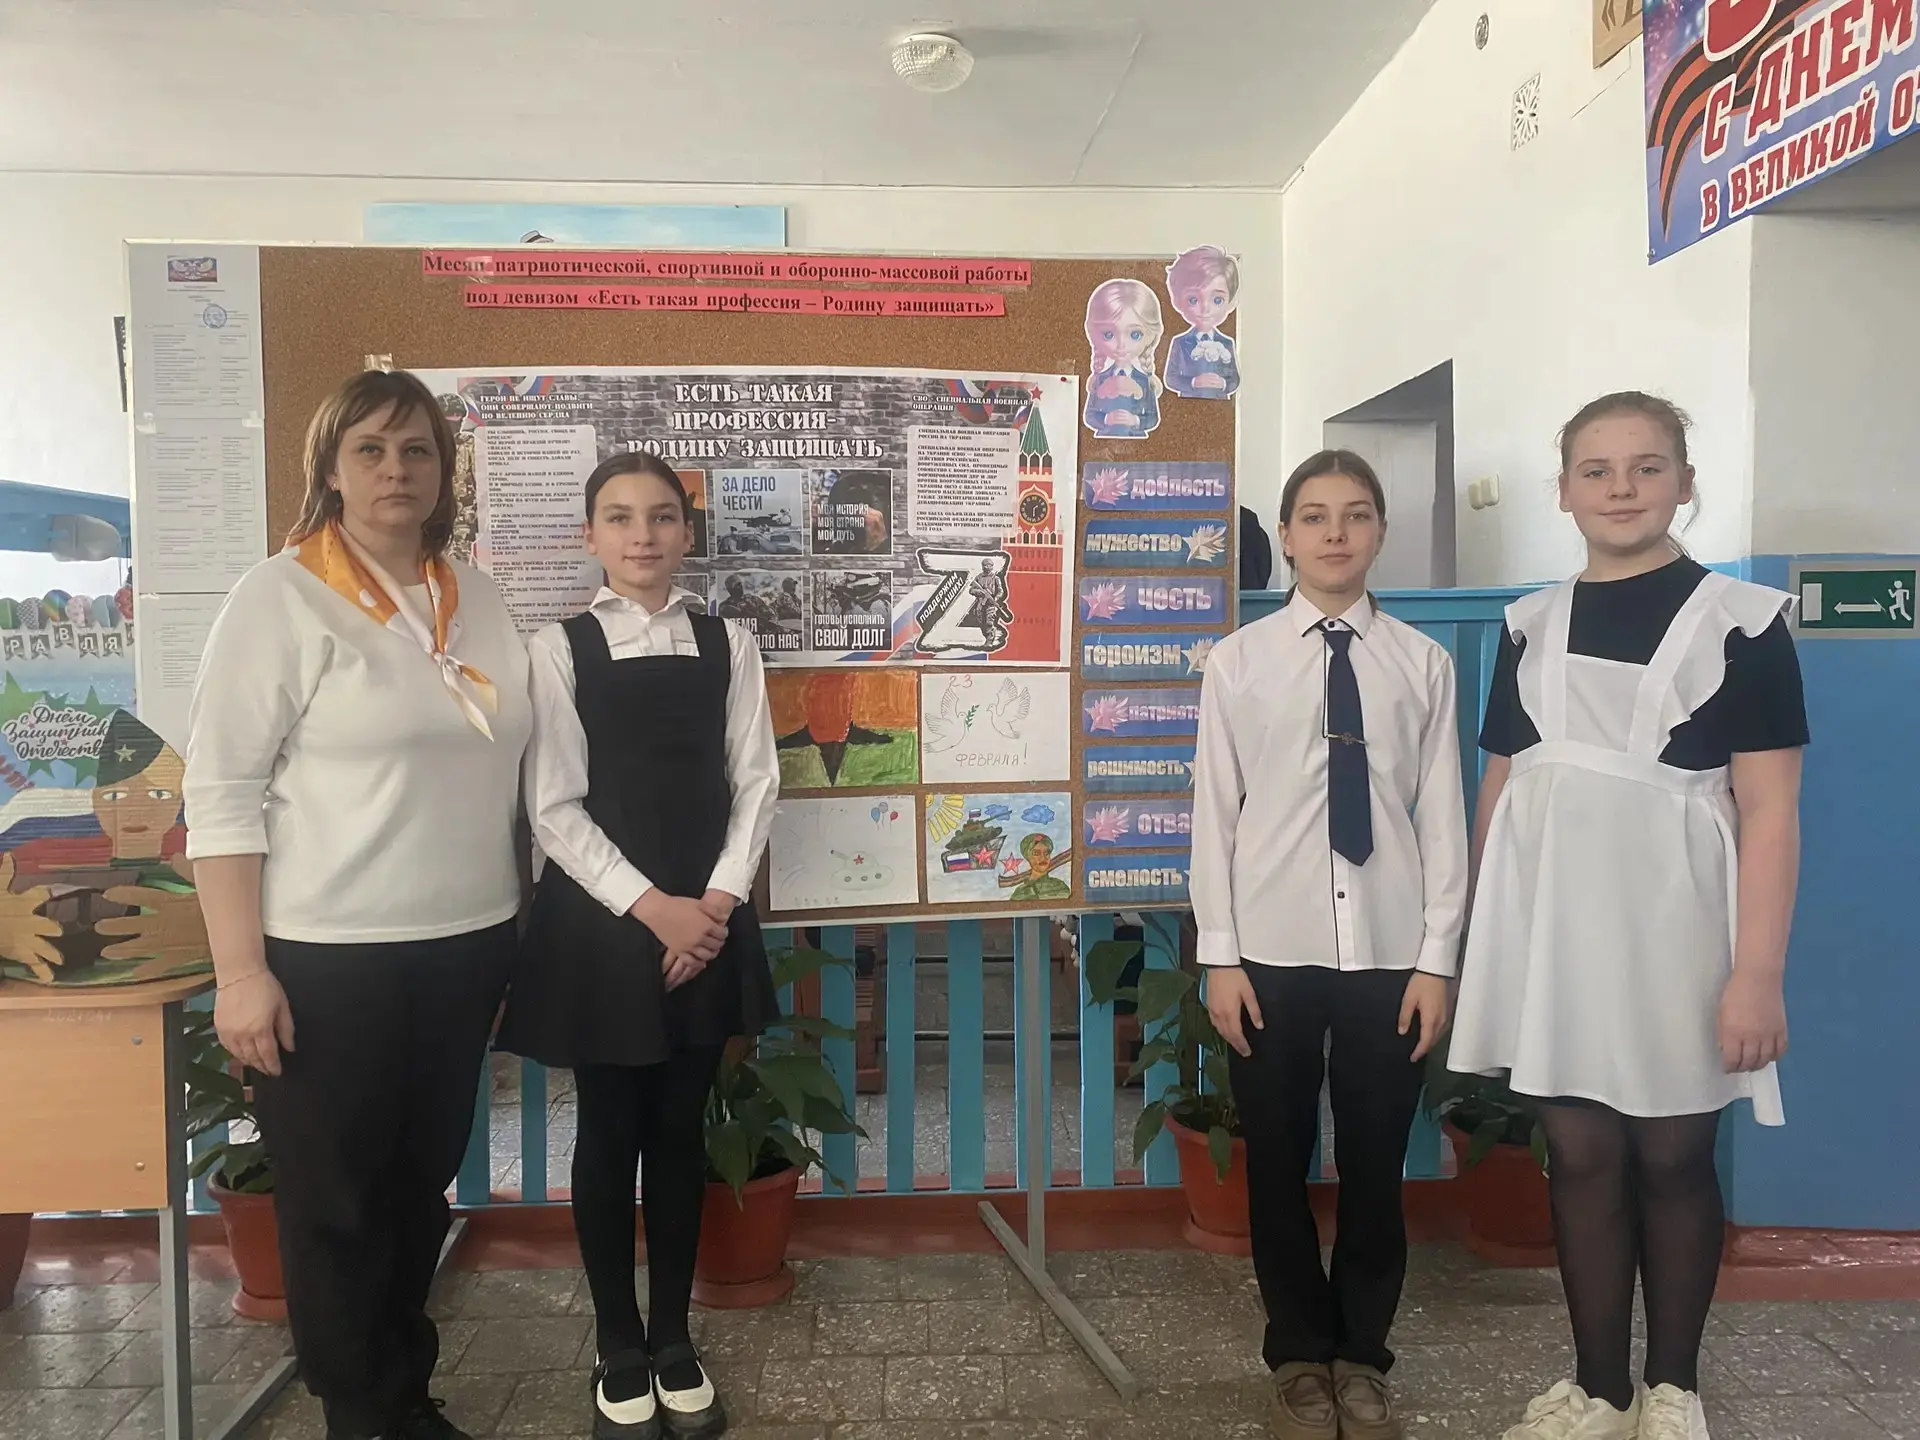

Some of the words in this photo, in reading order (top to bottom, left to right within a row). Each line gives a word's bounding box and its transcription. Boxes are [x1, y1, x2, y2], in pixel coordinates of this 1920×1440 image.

[1703, 79, 1735, 158] С
[1747, 0, 1914, 139] ДНЕМ
[1702, 182, 1719, 229] В
[1730, 88, 1877, 214] ВЕЛИКОЙ
[495, 257, 651, 276] патриотической,
[657, 259, 765, 279] спортивной
[770, 266, 781, 277] и
[788, 262, 959, 281] оборонно-массовой
[965, 263, 1028, 284] работы
[466, 291, 498, 306] под
[503, 292, 579, 306] девизом
[587, 289, 641, 306] «Есть
[646, 292, 699, 307] такая
[707, 292, 801, 313] профессия
[823, 295, 886, 316] Родину
[895, 300, 994, 315] защищать»
[674, 383, 740, 403] ЕСТЬ
[748, 383, 834, 403] ТАКАЯ
[936, 396, 991, 405] СПЕЦИАЛЬНАЯ
[912, 403, 954, 411] ОПЕРАЦИЯ
[673, 411, 837, 430] ПРОФЕССИЯ-
[626, 439, 731, 460] РОДИНУ
[740, 439, 884, 459] ЗАЩИЩАТЬ
[722, 477, 738, 492] ЗА
[742, 476, 776, 493] ДЕЛО
[1131, 475, 1225, 500] доблесть
[722, 495, 763, 511] ЧЕСТИ
[817, 504, 834, 515] МОЯ
[835, 503, 869, 515] ИСТОРИЯ
[817, 517, 834, 528] МОЯ
[836, 516, 865, 528] СТРАНА
[817, 528, 835, 541] МОЙ
[836, 529, 855, 541] ПУТЬ
[1086, 533, 1182, 553] мужество
[919, 571, 958, 624] ПОДДЕРЖИМ
[1137, 587, 1212, 611] честь
[814, 614, 842, 625] ГОТОВЫ
[842, 614, 885, 625] ИСПОЛНИТЬ
[778, 633, 800, 649] НАС
[815, 624, 848, 647] СВОЙ
[851, 628, 886, 650] ДОЛГ
[1084, 645, 1181, 667] героизм
[949, 674, 973, 689] 23
[4, 719, 109, 744] Защитник
[1087, 760, 1185, 778] решимость
[1137, 813, 1193, 834] отва
[1088, 868, 1183, 888] смелость
